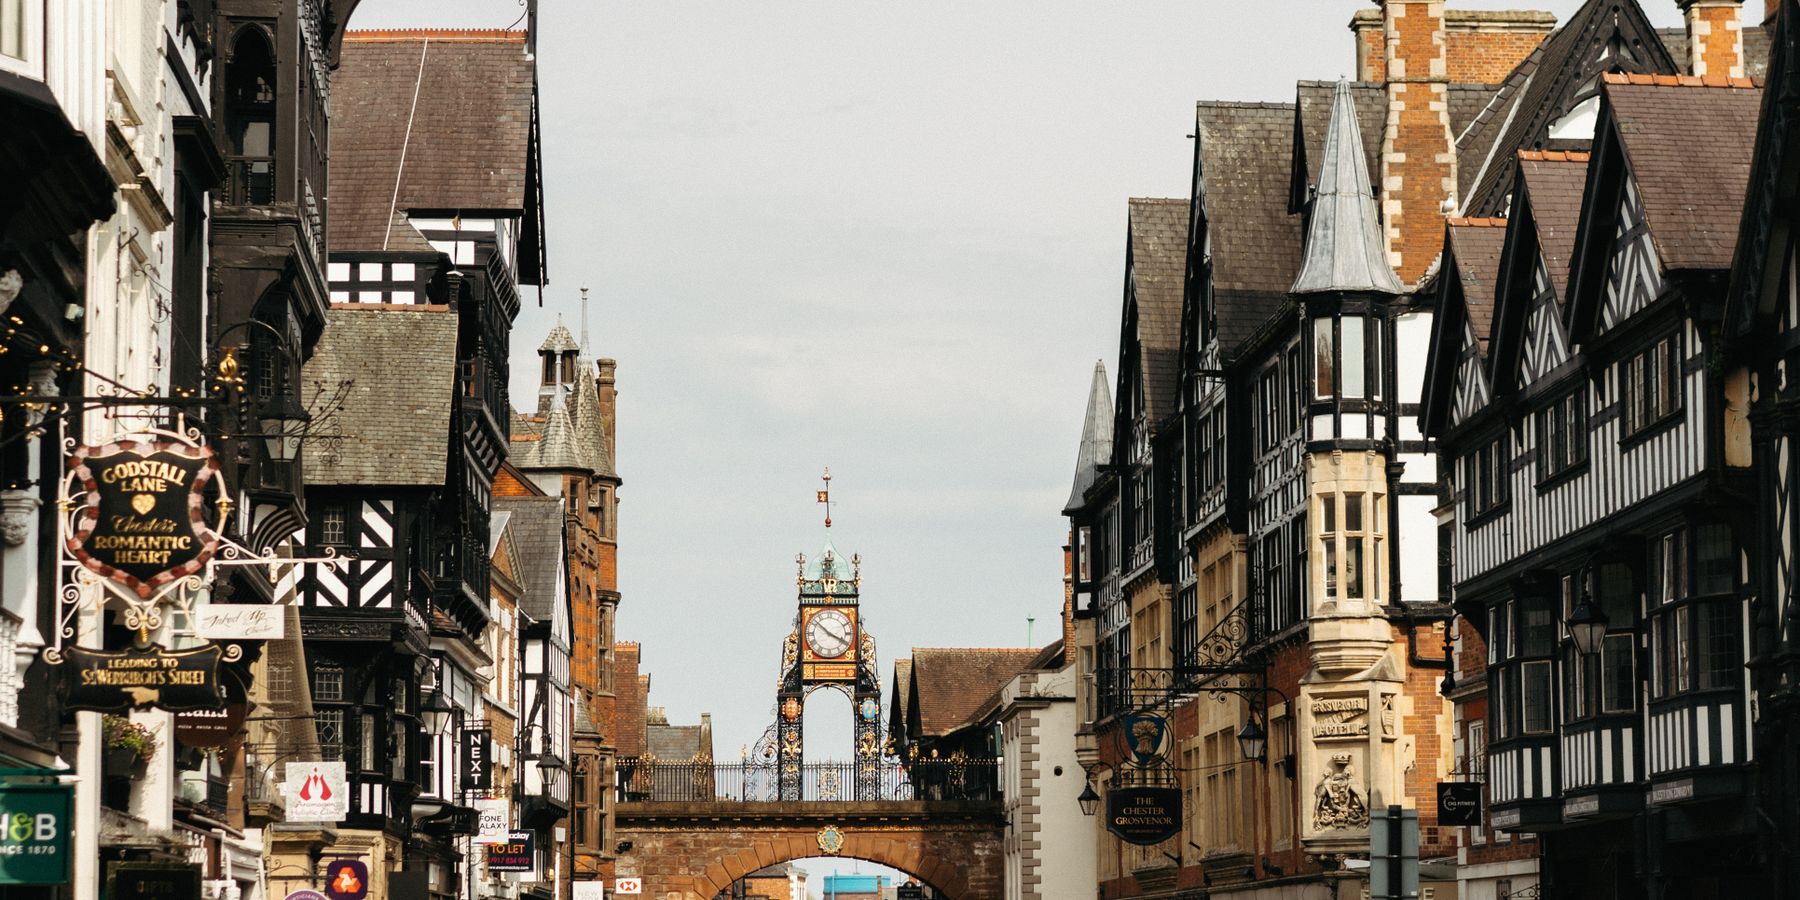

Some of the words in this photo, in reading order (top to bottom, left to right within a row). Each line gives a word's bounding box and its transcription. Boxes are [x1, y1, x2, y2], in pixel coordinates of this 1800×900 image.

[102, 460, 187, 487] GODSTALL
[121, 477, 168, 492] LANE
[111, 514, 178, 533] Chester's
[94, 535, 192, 550] ROMANTIC
[114, 550, 172, 564] HEART
[107, 658, 157, 668] LEADING
[161, 658, 178, 668] TO
[470, 734, 482, 785] NEXT
[1136, 797, 1154, 805] THE
[1122, 807, 1165, 815] CHESTER
[1115, 816, 1174, 825] GROSVENOR
[479, 822, 507, 830] ALAXY
[28, 845, 56, 855] 1870
[491, 844, 505, 854] TO
[507, 844, 525, 854] LET
